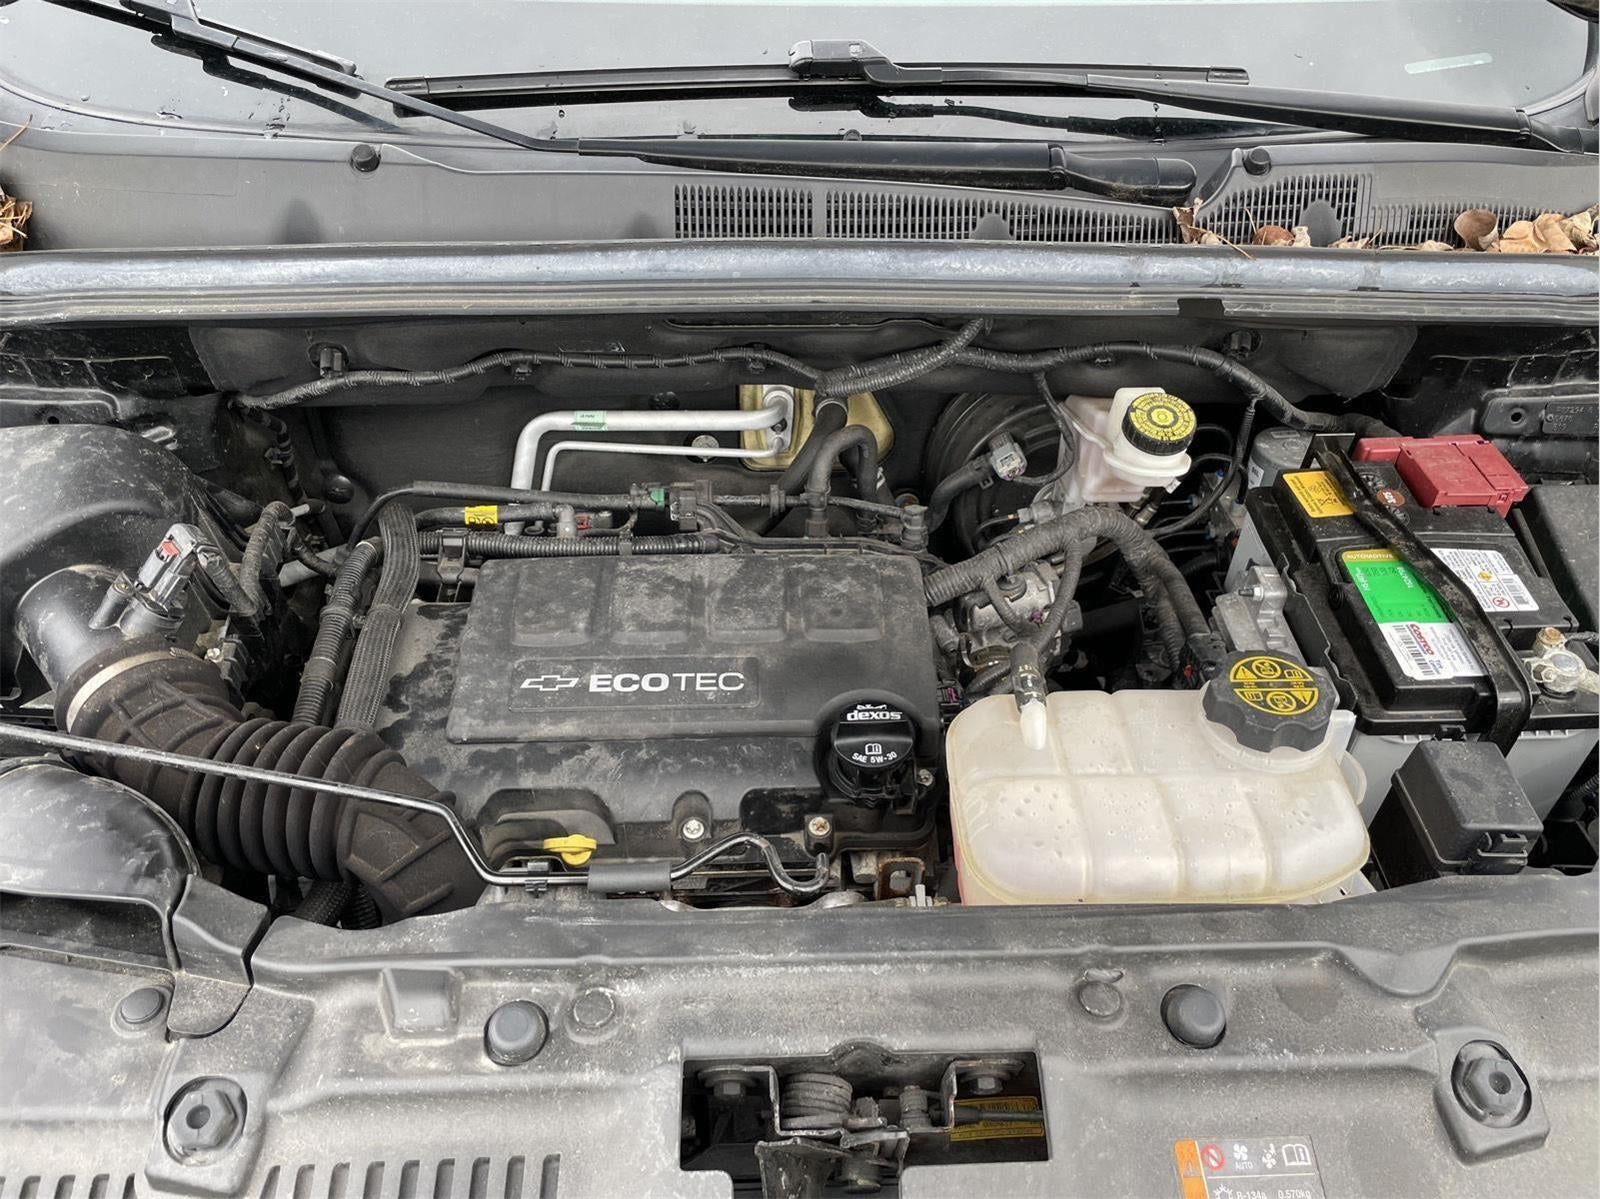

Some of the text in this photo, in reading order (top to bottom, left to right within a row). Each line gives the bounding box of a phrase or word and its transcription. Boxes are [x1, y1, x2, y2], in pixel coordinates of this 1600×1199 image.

[589, 672, 745, 692] ECOTEC
[846, 710, 902, 721] dexos
[852, 751, 897, 763] SAE 5W-30
[1235, 1161, 1253, 1169] AUTO
